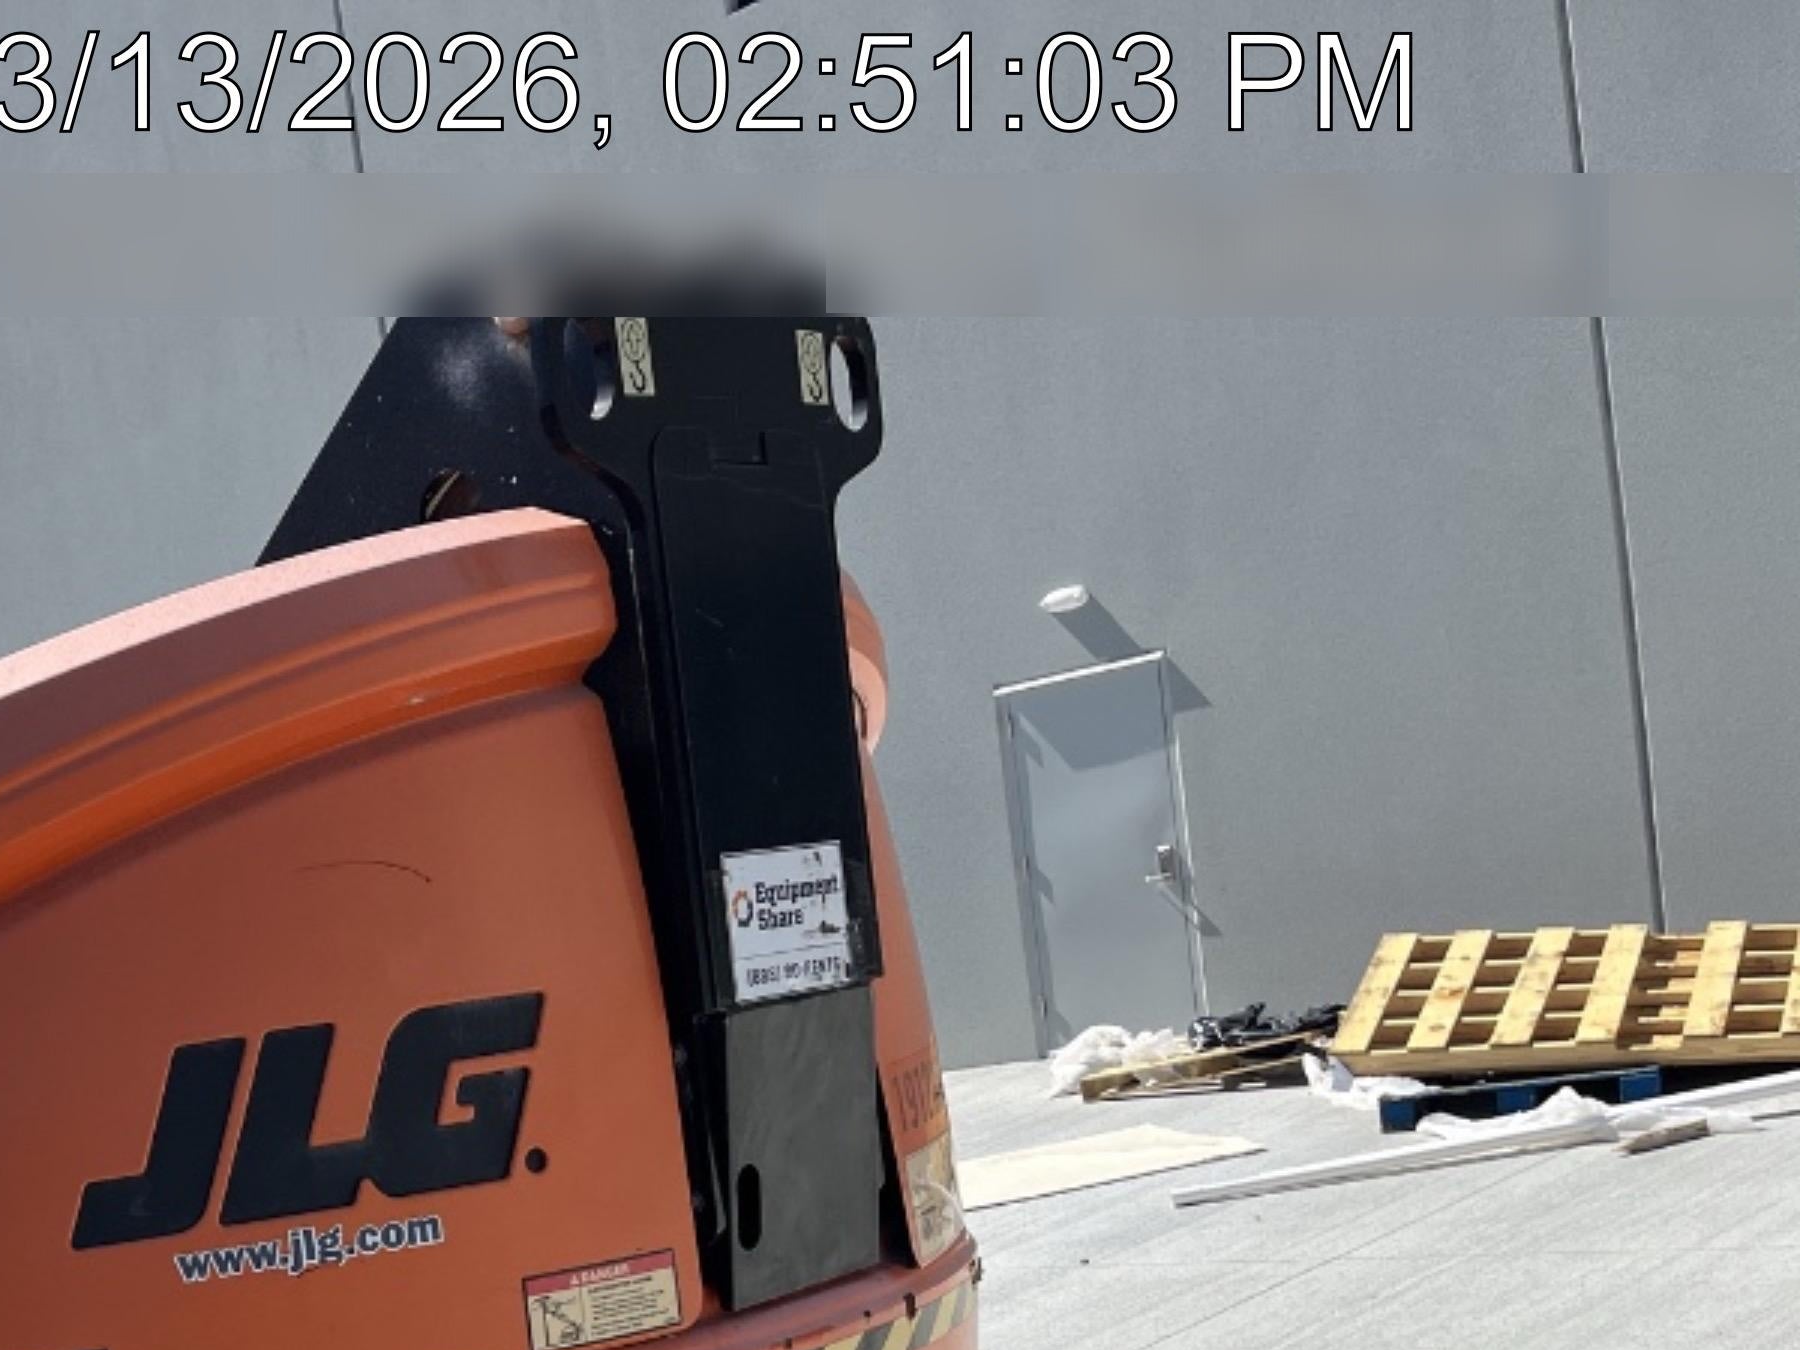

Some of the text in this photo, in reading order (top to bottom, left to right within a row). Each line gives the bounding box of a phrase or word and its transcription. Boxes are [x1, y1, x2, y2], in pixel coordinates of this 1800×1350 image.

[755, 874, 839, 908] Equipment
[757, 907, 805, 931] Share
[70, 991, 545, 1250] JLG
[174, 1214, 445, 1284] www.jlg.com
